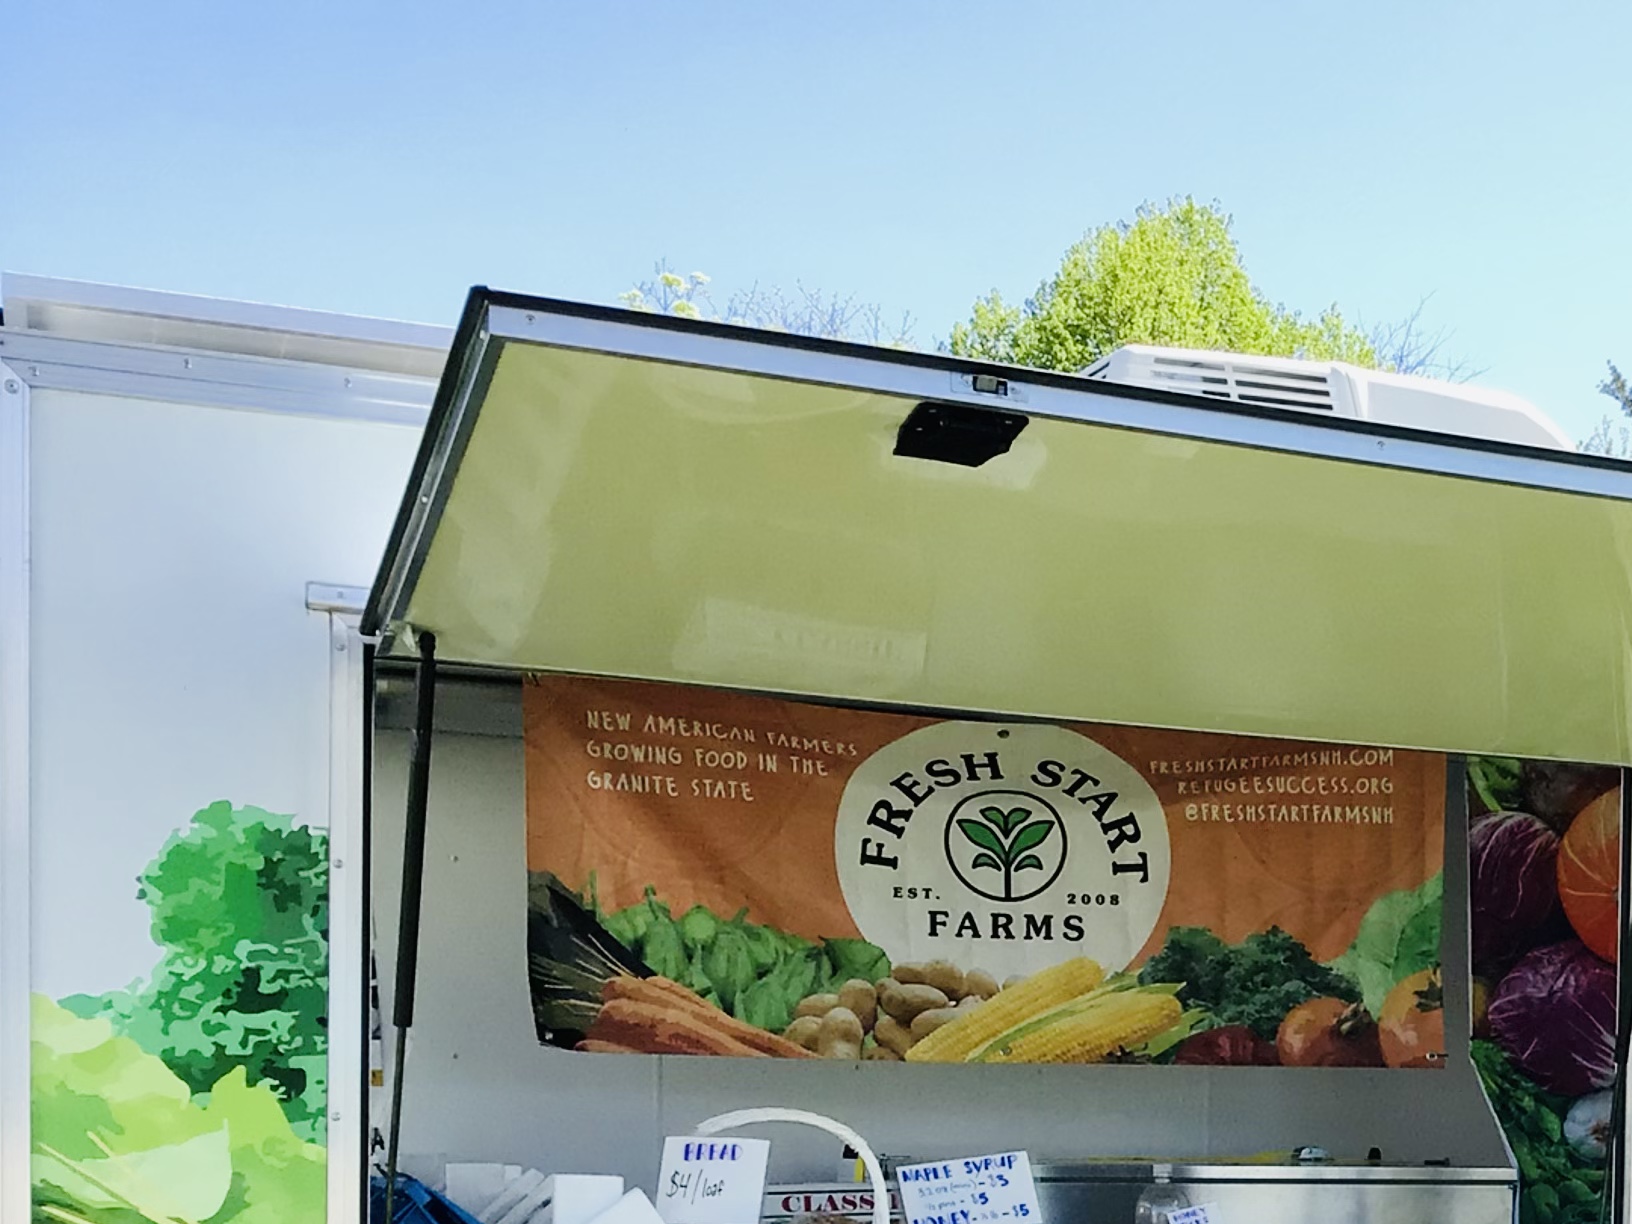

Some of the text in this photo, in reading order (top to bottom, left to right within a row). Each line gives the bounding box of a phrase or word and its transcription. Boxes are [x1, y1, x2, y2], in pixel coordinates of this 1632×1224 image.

[587, 709, 858, 757] NEW AMERICAN FARMERS
[587, 740, 829, 776] GROWING FOOD IN THE
[1150, 749, 1394, 775] FRESHSTARTFARMSNH.COM
[587, 770, 754, 801] GRANITE STATE
[1177, 776, 1394, 796] REFUGEESUCCESS.ORG
[860, 752, 1149, 884] FRESH START
[1185, 803, 1394, 825] @FRESHSTARTFARMSNH
[893, 886, 941, 900] EST.
[1067, 893, 1121, 905] 2008
[928, 910, 1085, 942] FARMS
[684, 1142, 743, 1162] BREAD
[902, 1154, 1018, 1183] MAPLE SYRUP
[666, 1169, 725, 1206] $4/loaf
